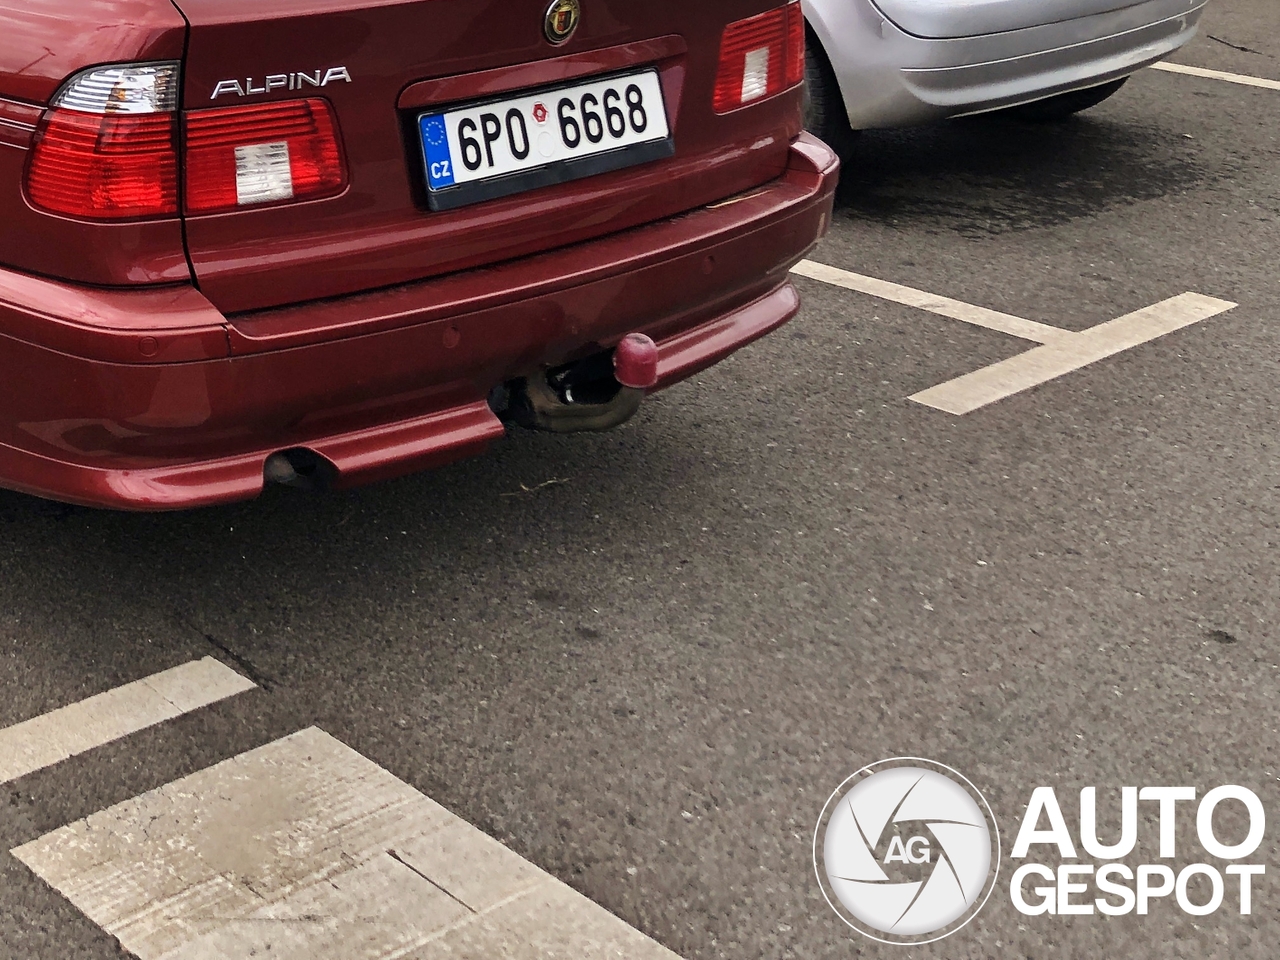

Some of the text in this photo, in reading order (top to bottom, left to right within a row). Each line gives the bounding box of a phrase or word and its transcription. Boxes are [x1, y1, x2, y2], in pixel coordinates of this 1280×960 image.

[210, 66, 352, 100] ALPINA
[556, 83, 648, 150] 6668
[431, 160, 451, 180] CZ
